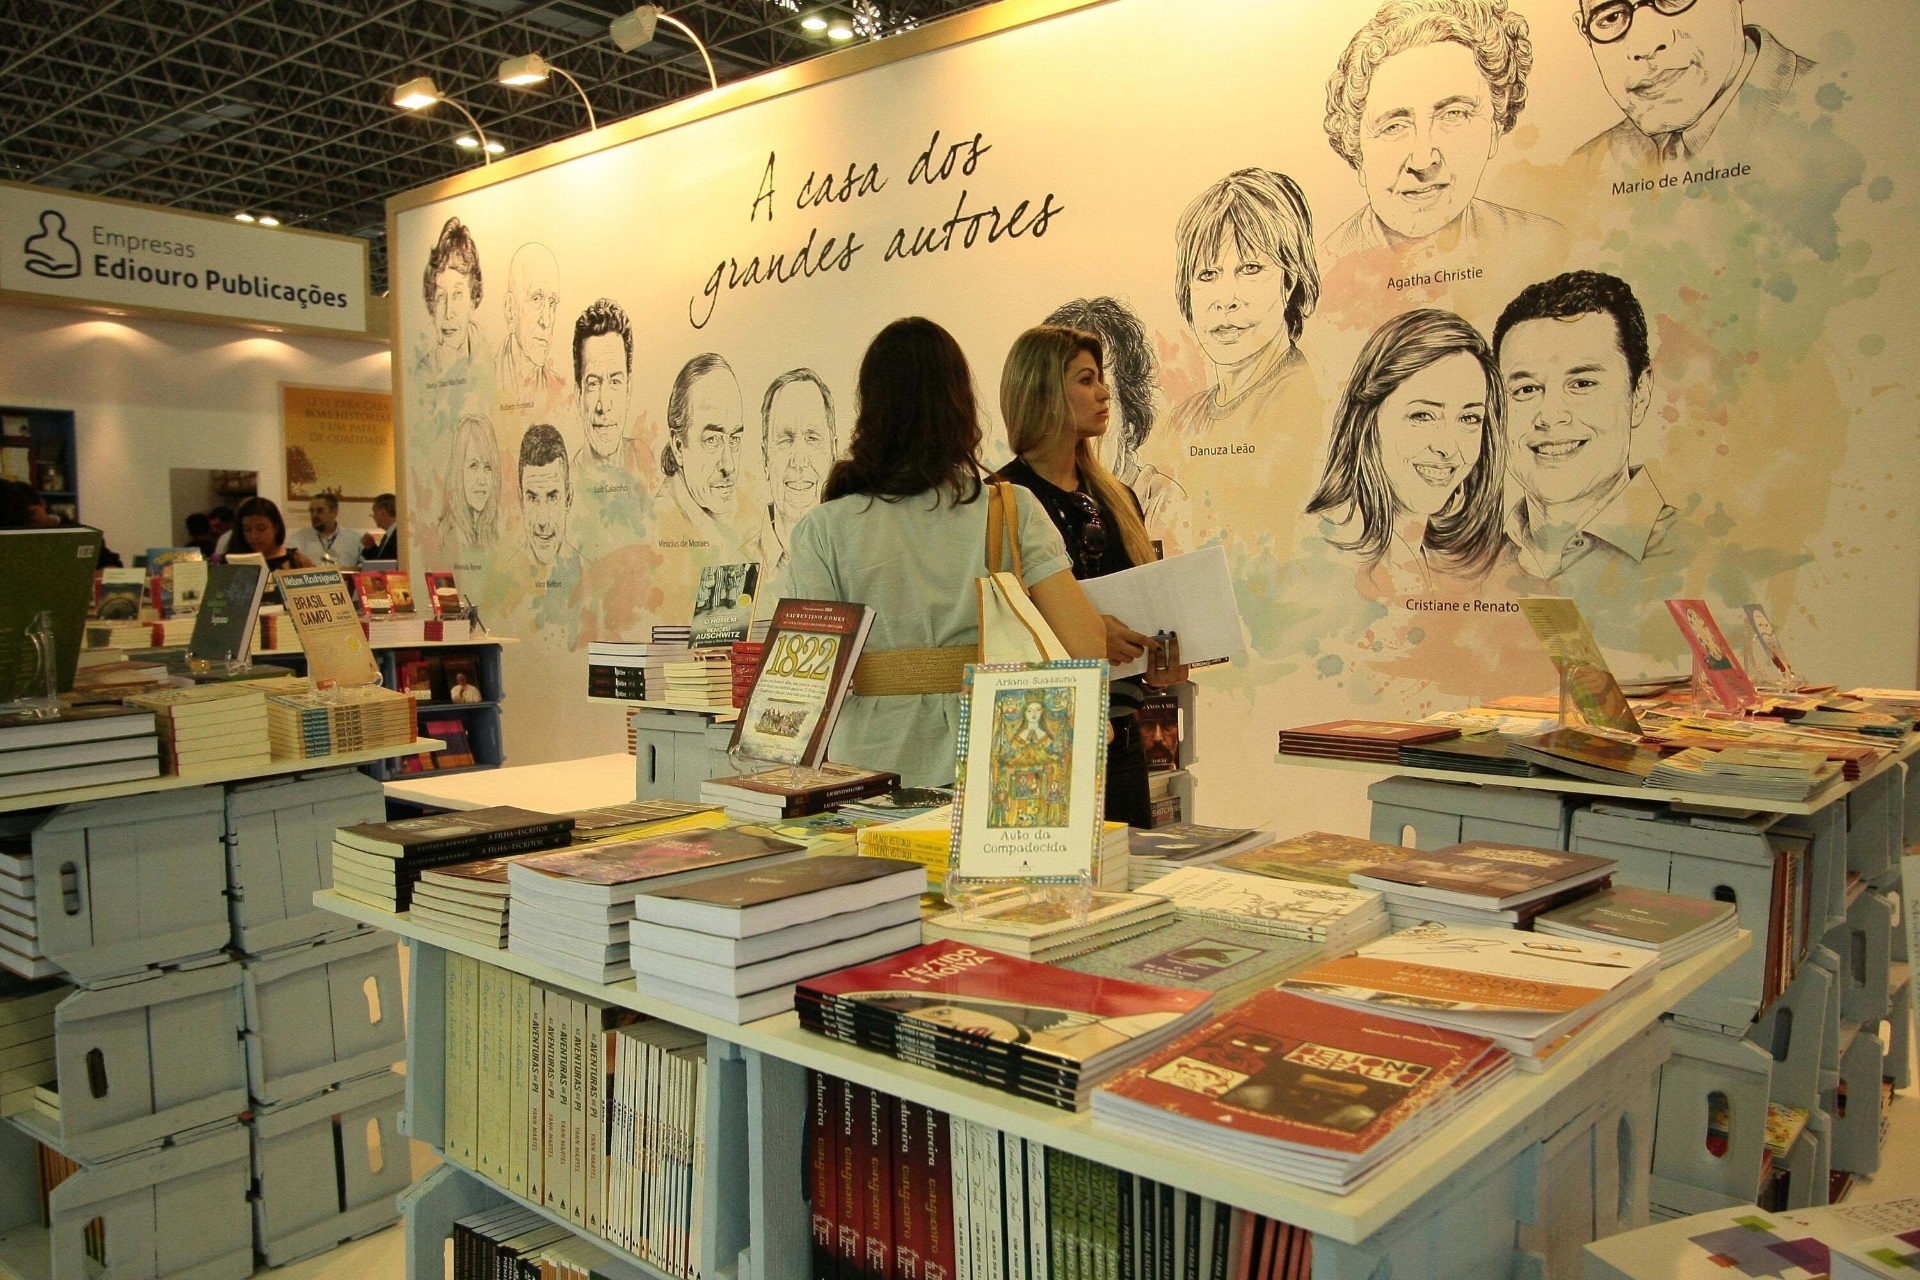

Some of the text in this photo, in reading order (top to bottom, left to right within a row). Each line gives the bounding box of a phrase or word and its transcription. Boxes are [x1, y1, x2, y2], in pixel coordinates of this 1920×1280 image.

[751, 130, 992, 222] A casa dos
[1612, 162, 1750, 195] Mario de Andrade
[93, 226, 195, 258] Empresas
[690, 190, 1064, 329] grandes autores
[94, 255, 348, 309] Ediouro Publicações
[1387, 267, 1483, 291] Agatha Christie
[1190, 443, 1256, 456] Danuza Leão
[303, 572, 340, 586] Rodrigues
[293, 594, 327, 610] BRASIL
[330, 592, 346, 606] EM
[1406, 598, 1519, 612] Cristiane e Renato
[300, 610, 333, 626] CAMPO
[695, 632, 740, 640] AUSCHWITZ
[766, 634, 837, 680] 1822
[995, 675, 1077, 686] Ariano Suassuna
[983, 843, 1067, 855] Compadecida
[1000, 830, 1050, 841] Auto da
[890, 948, 977, 979] VESTIDO
[532, 1018, 540, 1074] AVENTURAS
[547, 1024, 555, 1080] AVENTURAS
[560, 1030, 568, 1086] AVENTURAS
[574, 1035, 582, 1092] AVENTURAS
[590, 1041, 598, 1099] AVENTURAS
[532, 1083, 539, 1093] PI
[548, 1088, 554, 1098] PI
[560, 1095, 567, 1105] PI
[574, 1101, 581, 1111] PI
[590, 1108, 597, 1118] PI
[1053, 1230, 1061, 1265] TEMPO
[1066, 1233, 1074, 1270] TEMPO
[1080, 1238, 1088, 1275] TEMPO
[1108, 1249, 1116, 1280] TEMP
